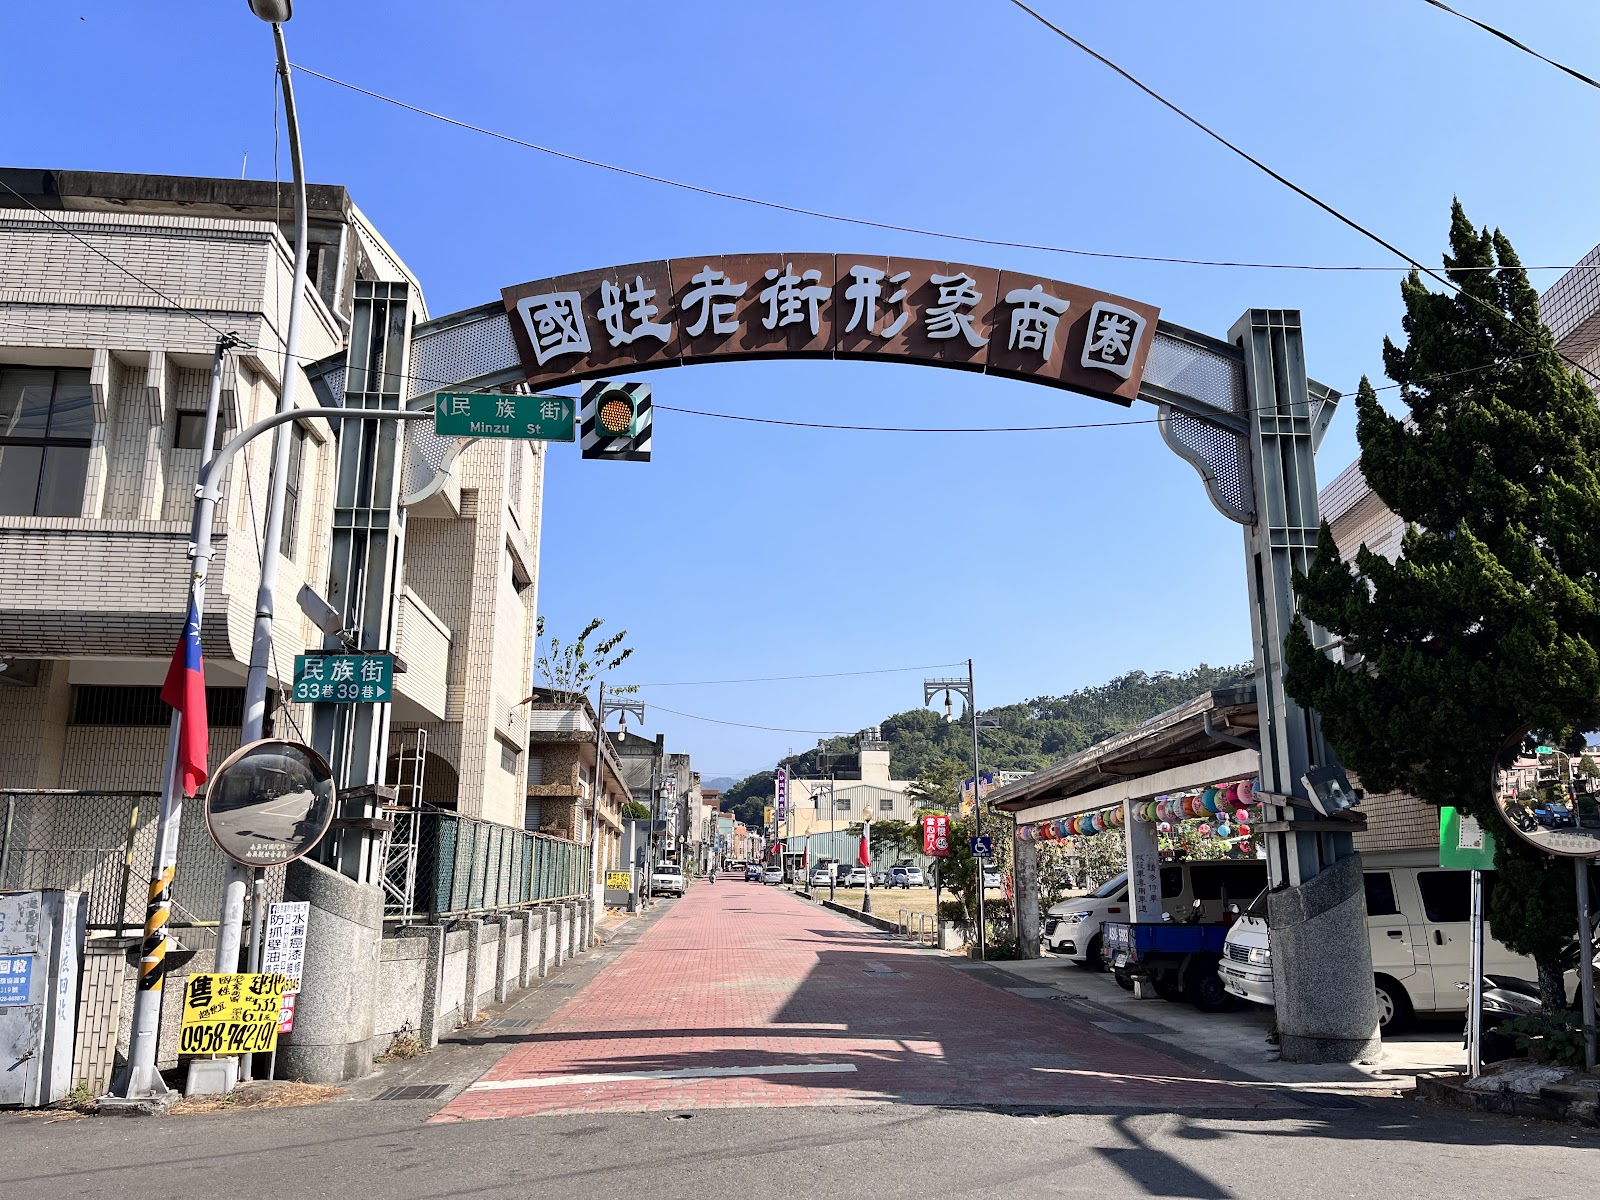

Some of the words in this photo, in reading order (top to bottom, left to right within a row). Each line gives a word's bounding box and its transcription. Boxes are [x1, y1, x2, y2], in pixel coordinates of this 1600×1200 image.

[516, 262, 1147, 379] 國姓老街形象商圈
[450, 397, 561, 420] 民族街
[470, 421, 509, 433] Minzu
[526, 423, 545, 434] St.
[302, 659, 383, 682] 民族街
[926, 817, 935, 851] 當心行人
[189, 974, 213, 1008] 售
